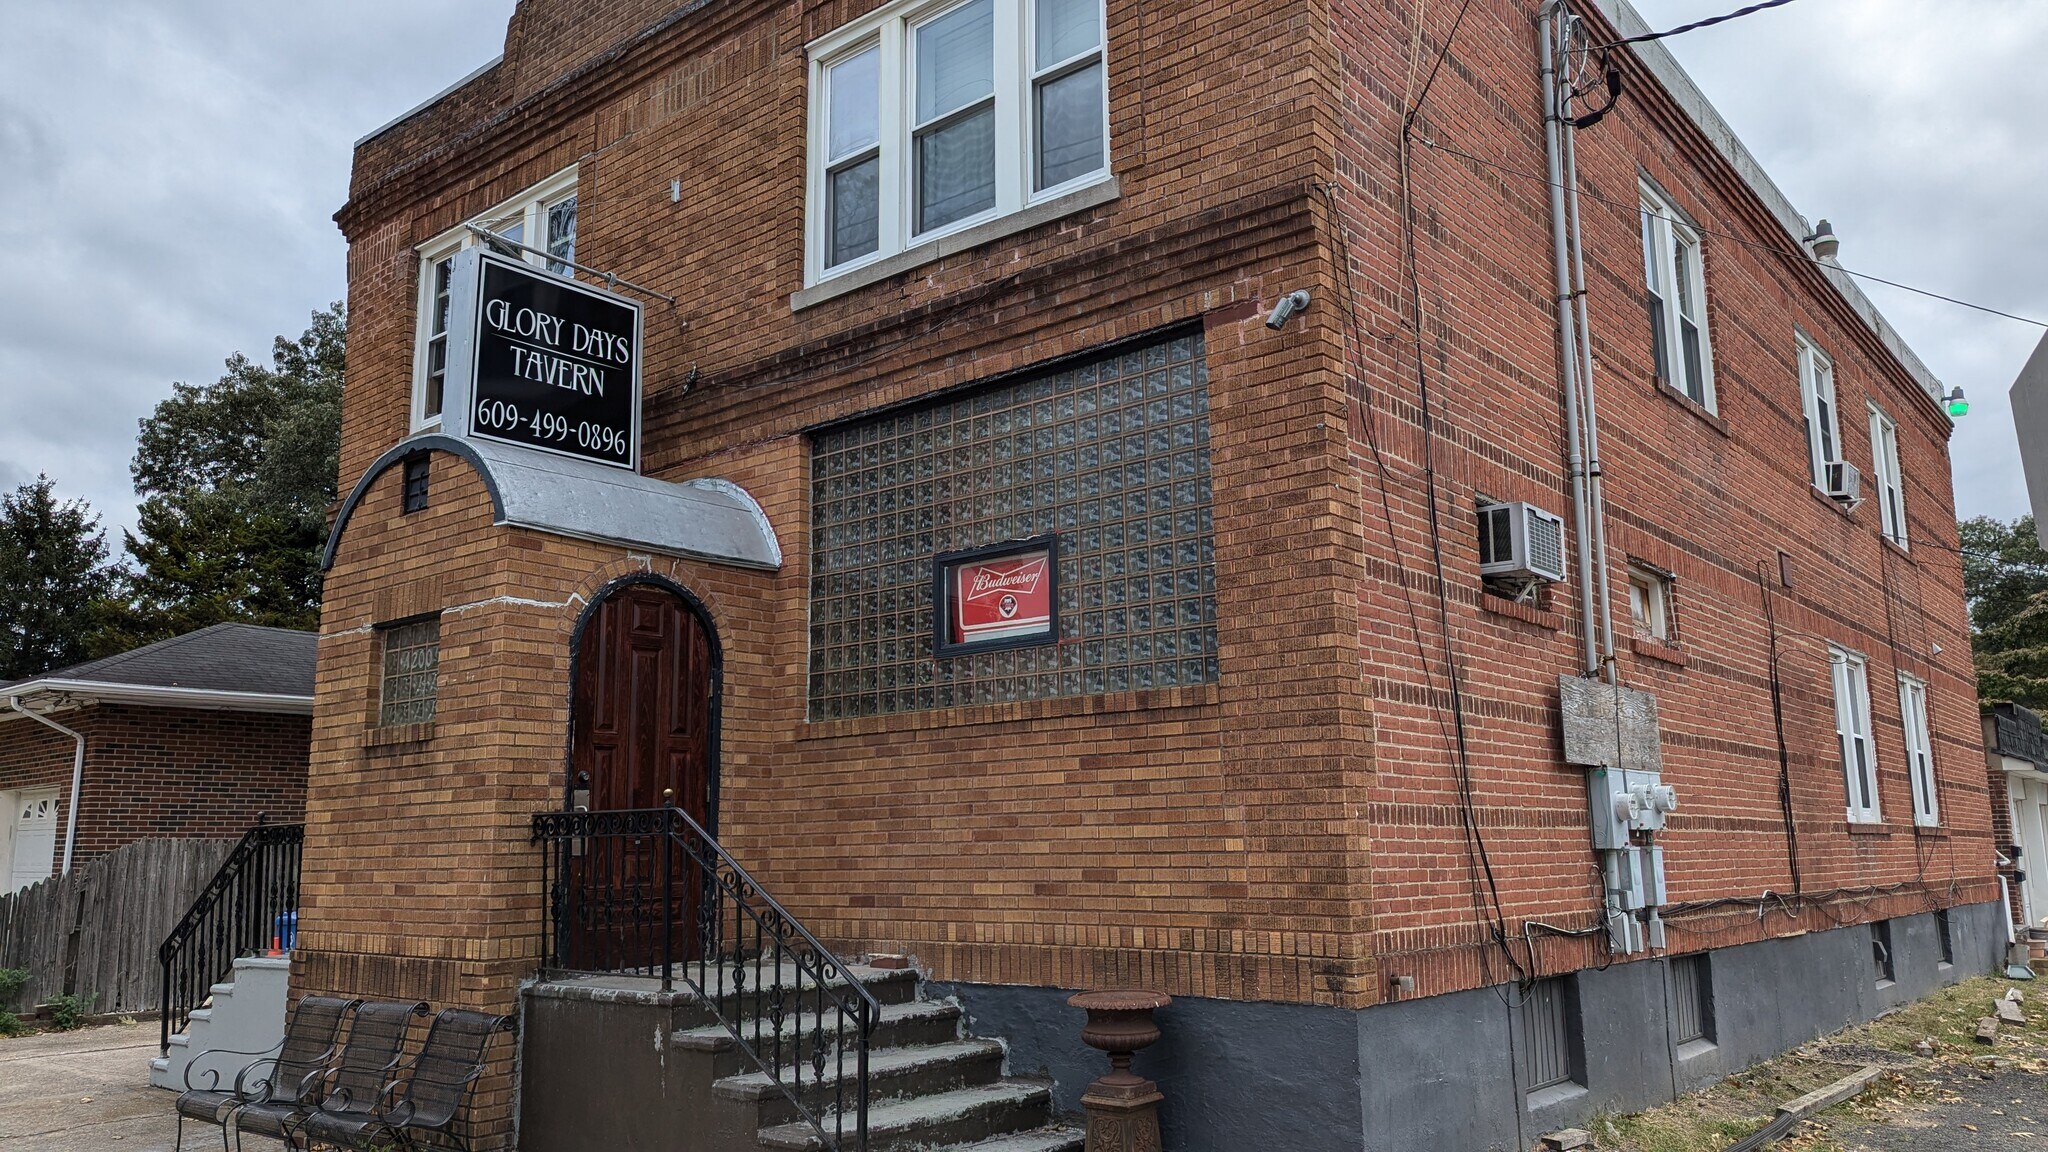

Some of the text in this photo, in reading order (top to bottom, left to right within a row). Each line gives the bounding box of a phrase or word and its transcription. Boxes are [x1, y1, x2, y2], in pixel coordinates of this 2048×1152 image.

[486, 299, 629, 364] GLORY DAYS
[510, 346, 604, 398] TAVERN
[478, 398, 626, 455] 609-499-0896
[973, 571, 1040, 591] Budweiser
